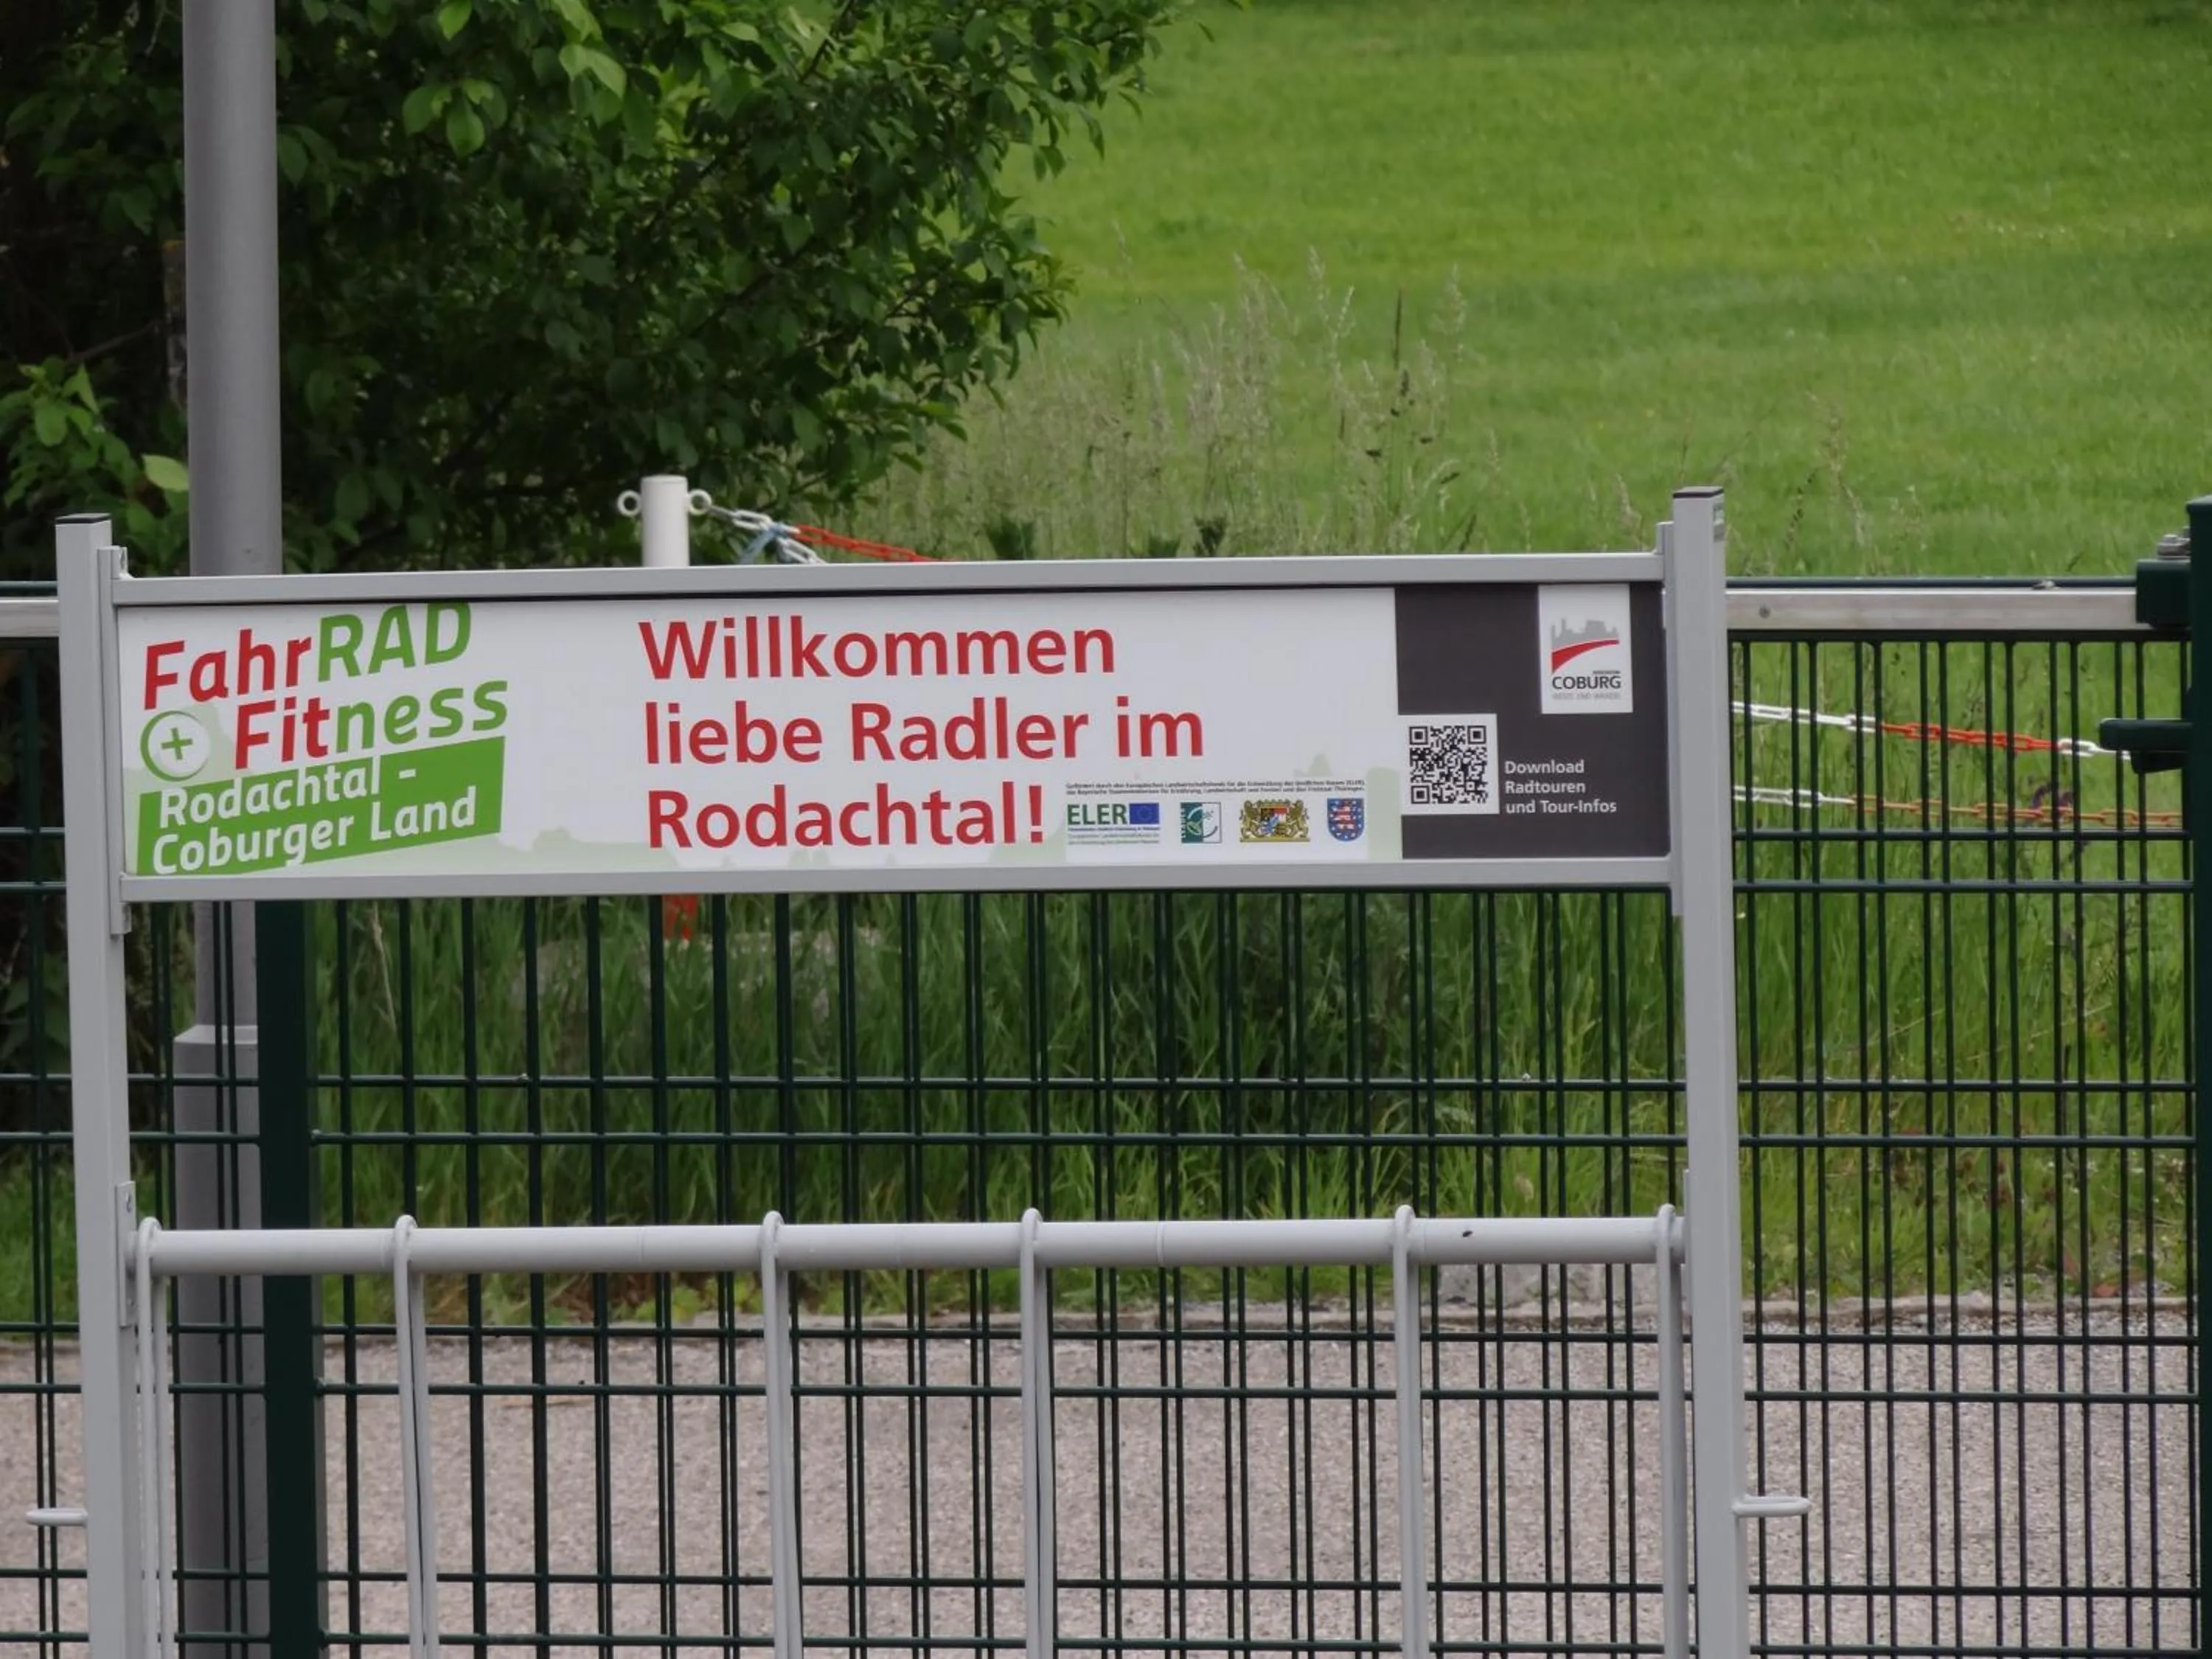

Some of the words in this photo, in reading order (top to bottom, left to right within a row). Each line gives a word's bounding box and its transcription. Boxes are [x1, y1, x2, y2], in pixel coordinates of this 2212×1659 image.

[144, 602, 471, 710] FahrRAD
[638, 615, 1115, 680] Willkommen
[1551, 675, 1621, 690] COBURG
[235, 680, 508, 770] Fitness
[644, 700, 822, 765] liebe
[851, 697, 1089, 762] Radler
[1116, 695, 1204, 758] im
[159, 756, 380, 829] Rodachtal
[1504, 759, 1585, 775] Download
[1504, 779, 1586, 794] Radtouren
[153, 815, 355, 875] Coburger
[370, 785, 476, 842] Land
[647, 781, 1046, 849] Rodachtal!
[1067, 803, 1128, 825] ELER
[1506, 800, 1536, 814] und
[1540, 799, 1617, 813] Tour-Infos
